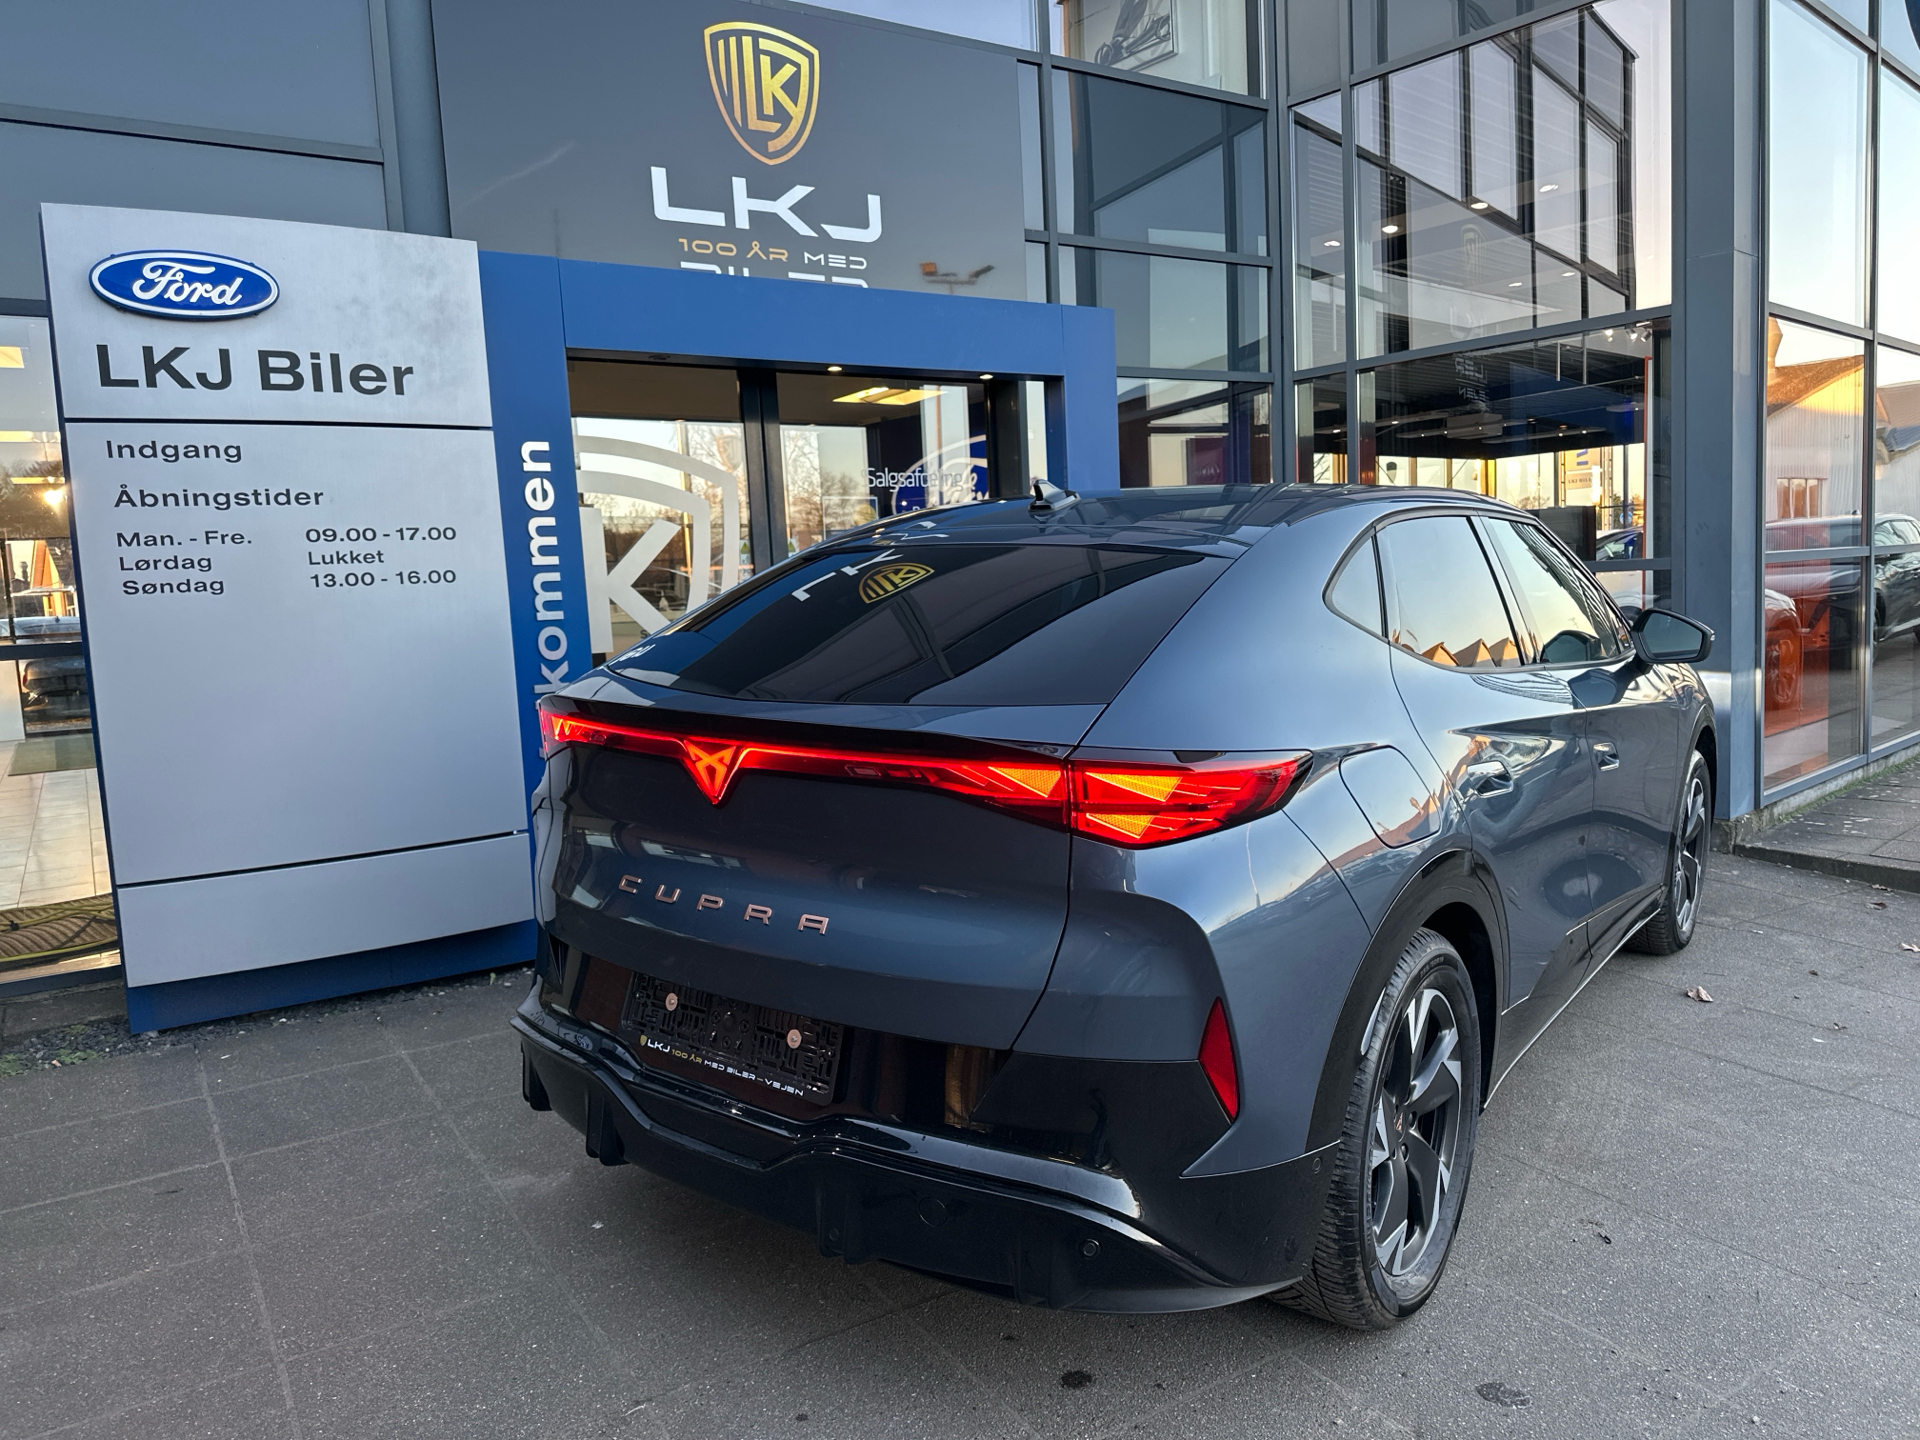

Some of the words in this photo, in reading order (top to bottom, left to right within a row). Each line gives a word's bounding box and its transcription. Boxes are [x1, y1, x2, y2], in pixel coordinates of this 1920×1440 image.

[651, 166, 882, 243] LKJ
[678, 238, 737, 257] 100
[746, 241, 789, 262] ÅR
[804, 251, 868, 270] MED
[132, 260, 243, 306] Ford
[96, 344, 232, 391] LKJ
[257, 349, 414, 396] Biler
[106, 440, 243, 463] Indgang
[114, 483, 324, 511] Åbningstider
[116, 531, 183, 547] Man.
[204, 530, 252, 546] Fre.
[305, 526, 377, 543] 09.00
[395, 526, 457, 541] 17.00
[119, 555, 213, 572] Lørdag
[308, 550, 385, 566] Lukket
[521, 440, 571, 696] kommen
[122, 578, 225, 595] Søndag
[310, 571, 375, 588] 13.00
[395, 569, 457, 585] 16.00
[618, 874, 830, 935] CUPRA
[647, 1038, 671, 1053] LKJ
[671, 1049, 688, 1060] 100
[704, 1059, 725, 1071] MED
